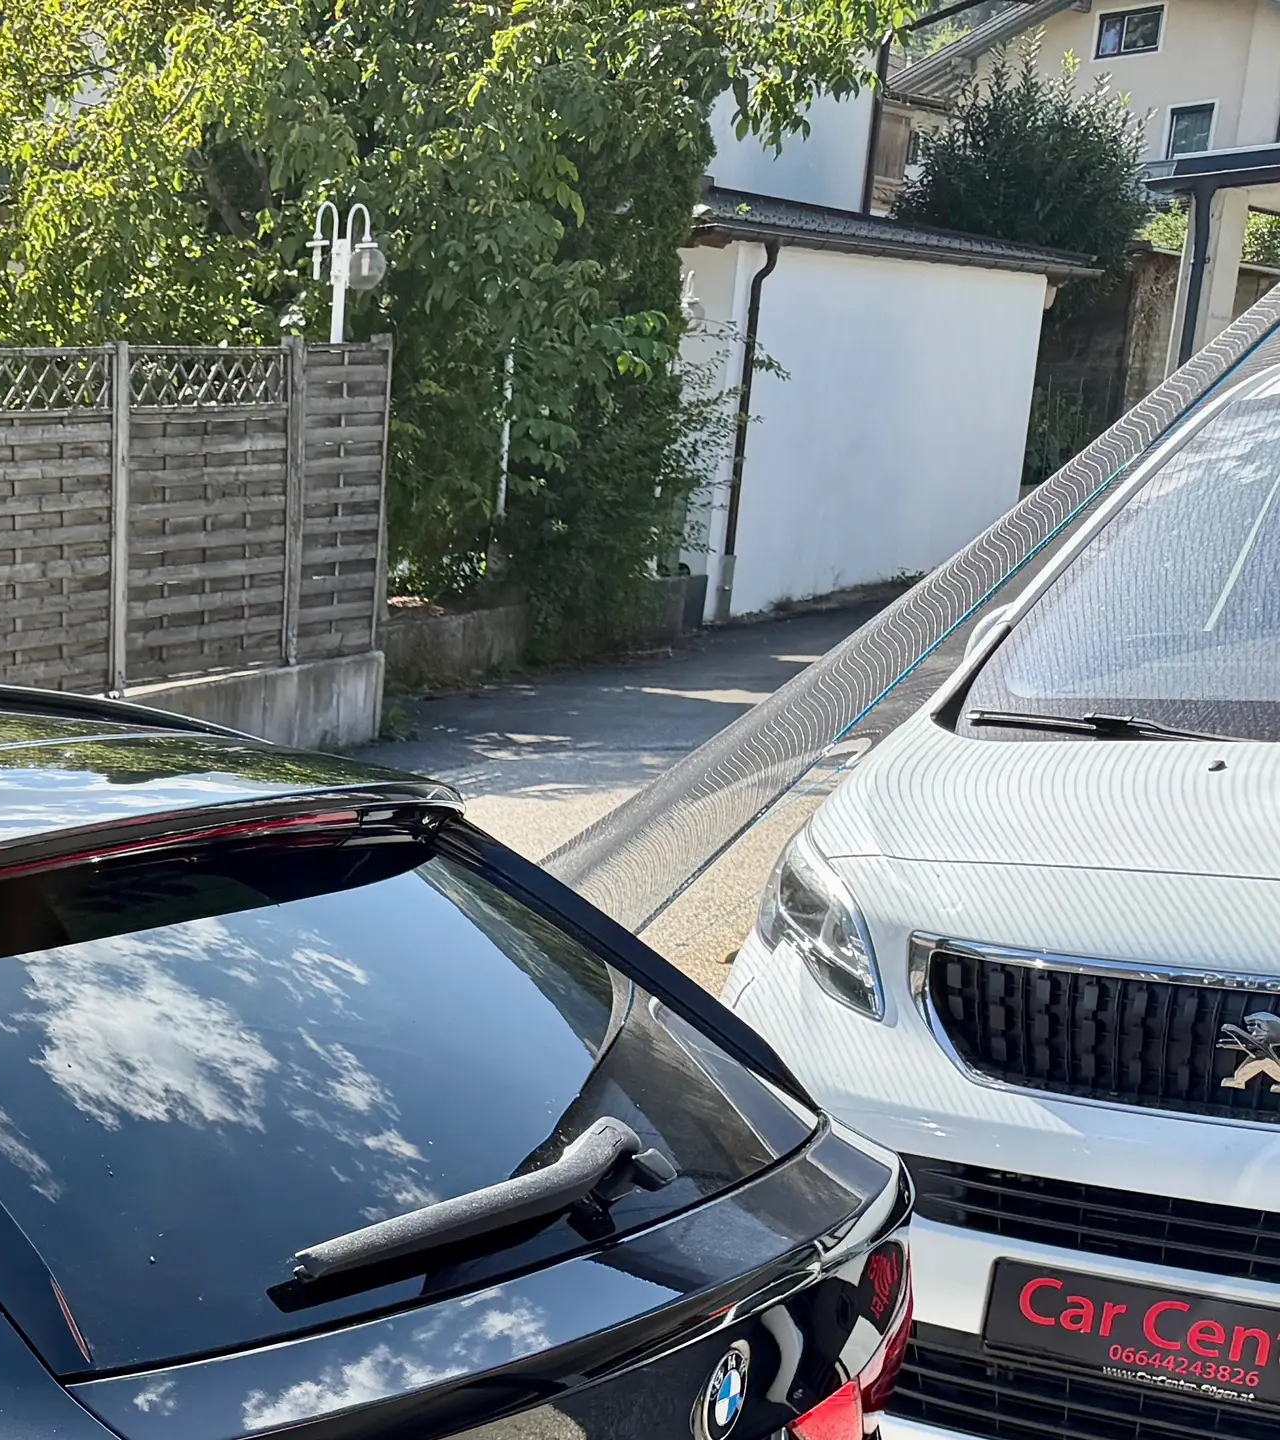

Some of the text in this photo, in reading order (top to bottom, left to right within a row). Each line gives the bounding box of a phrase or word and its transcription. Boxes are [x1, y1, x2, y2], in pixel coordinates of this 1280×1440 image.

[1019, 1277, 1280, 1368] Car Cen
[1108, 1343, 1260, 1388] 06644243826
